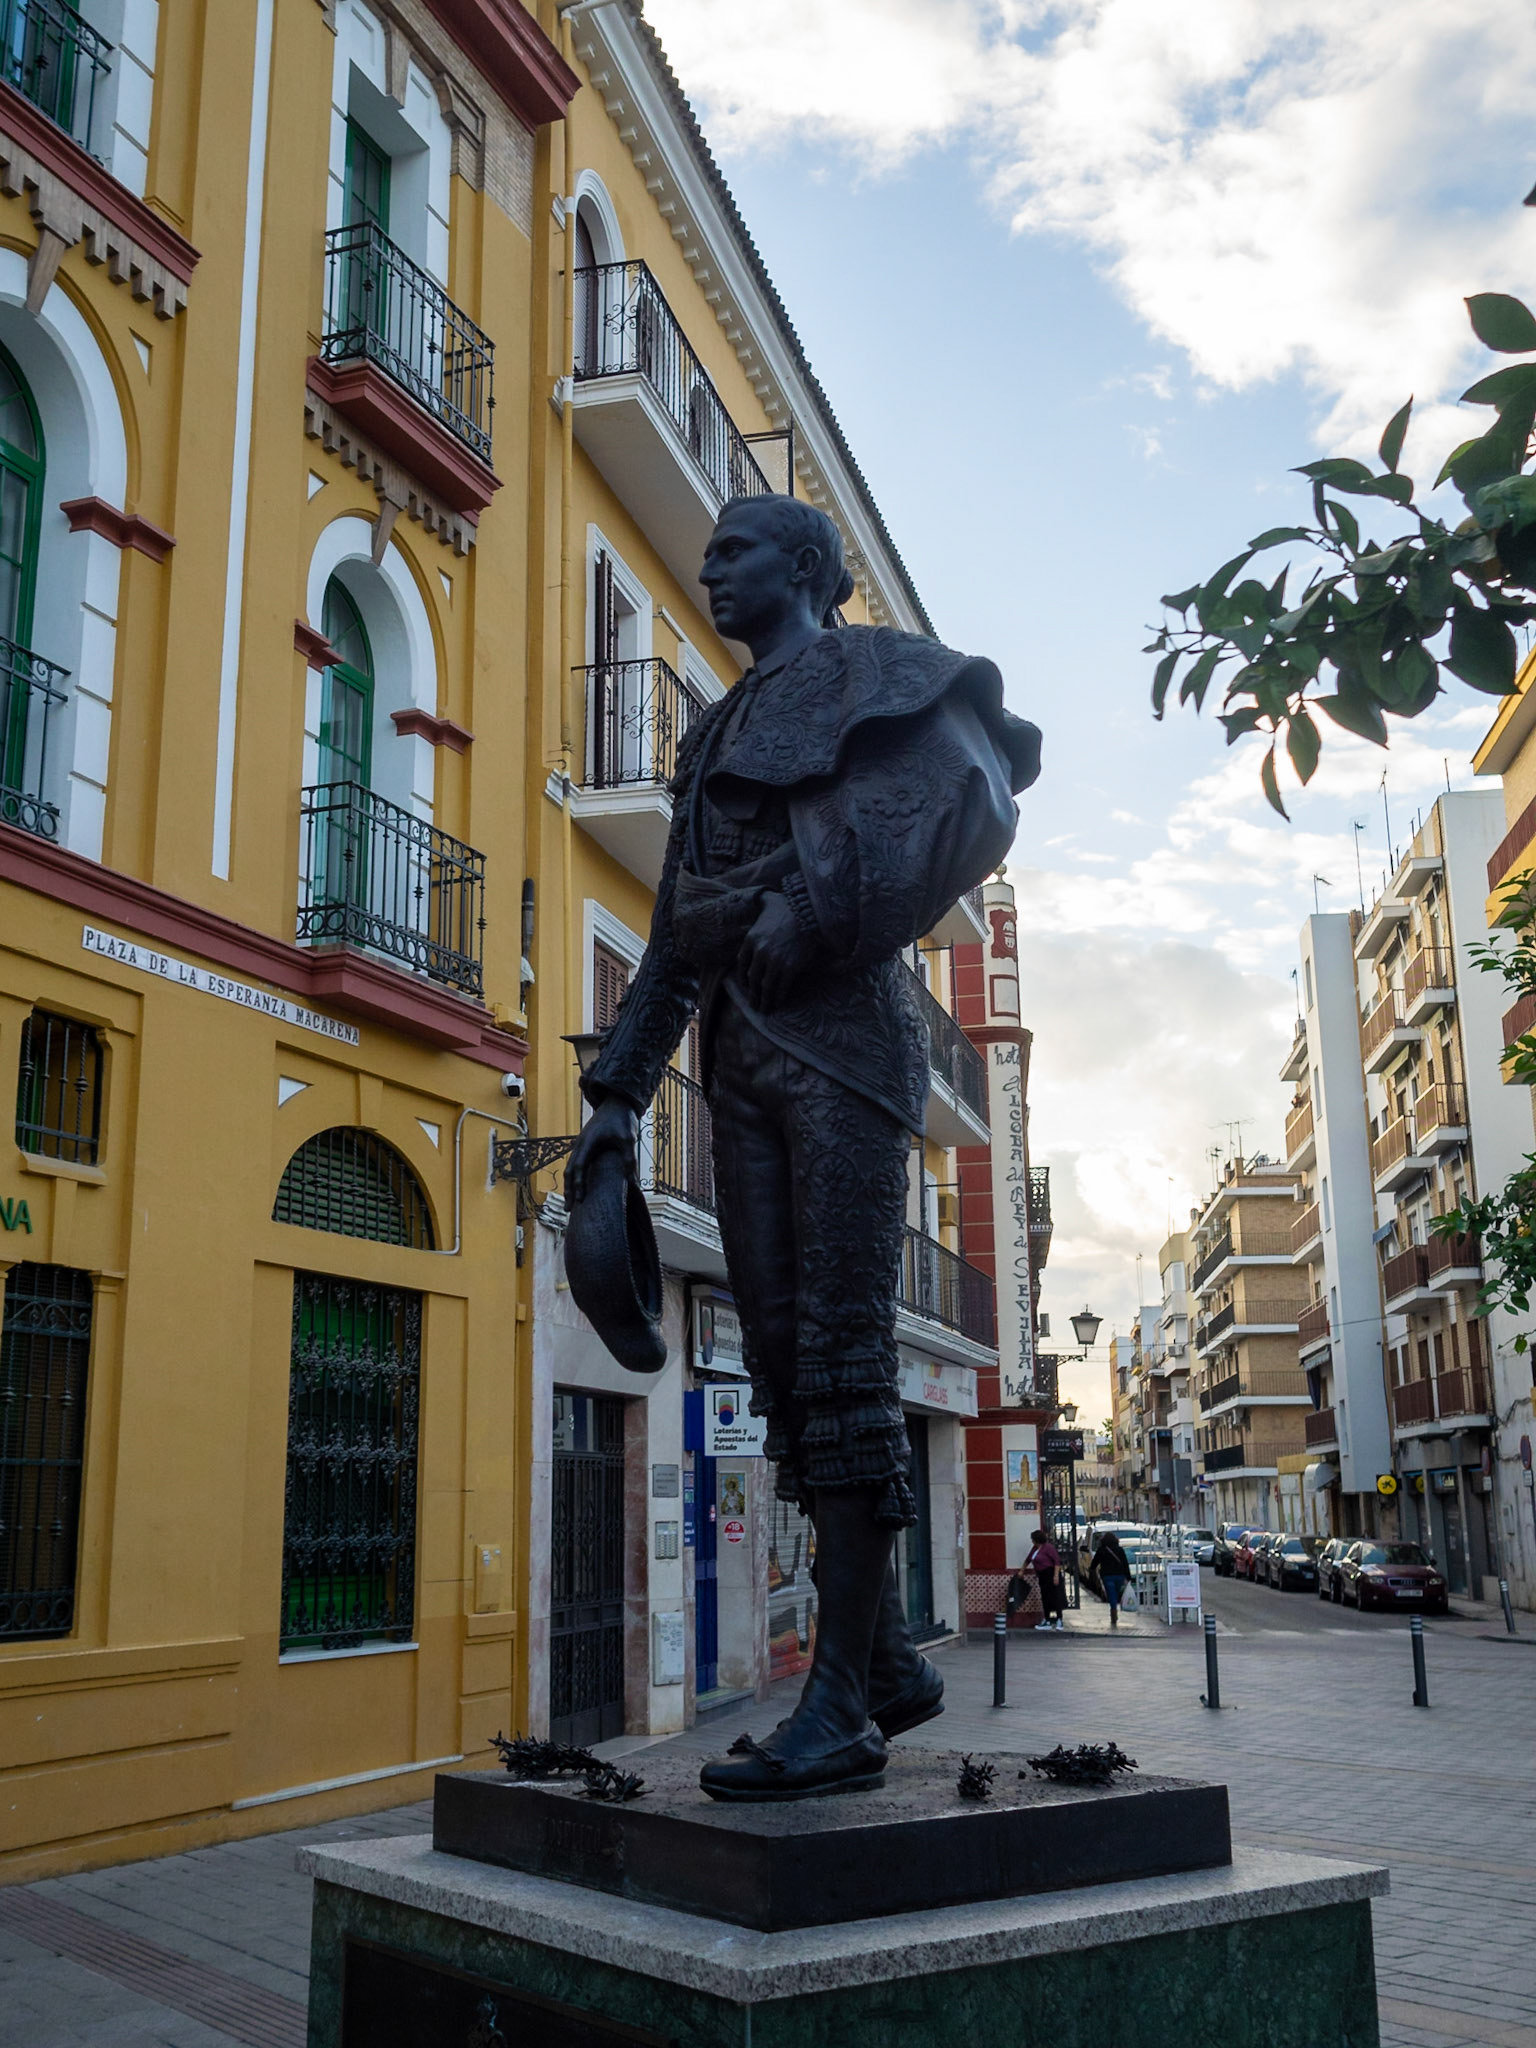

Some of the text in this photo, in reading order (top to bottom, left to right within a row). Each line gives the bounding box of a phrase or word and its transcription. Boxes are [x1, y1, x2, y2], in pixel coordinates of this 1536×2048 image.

[86, 930, 360, 1043] PLAZA DE LA ESPERANZA MACARENA
[924, 1382, 948, 1405] CARGLASS
[714, 1436, 746, 1444] Apuestas
